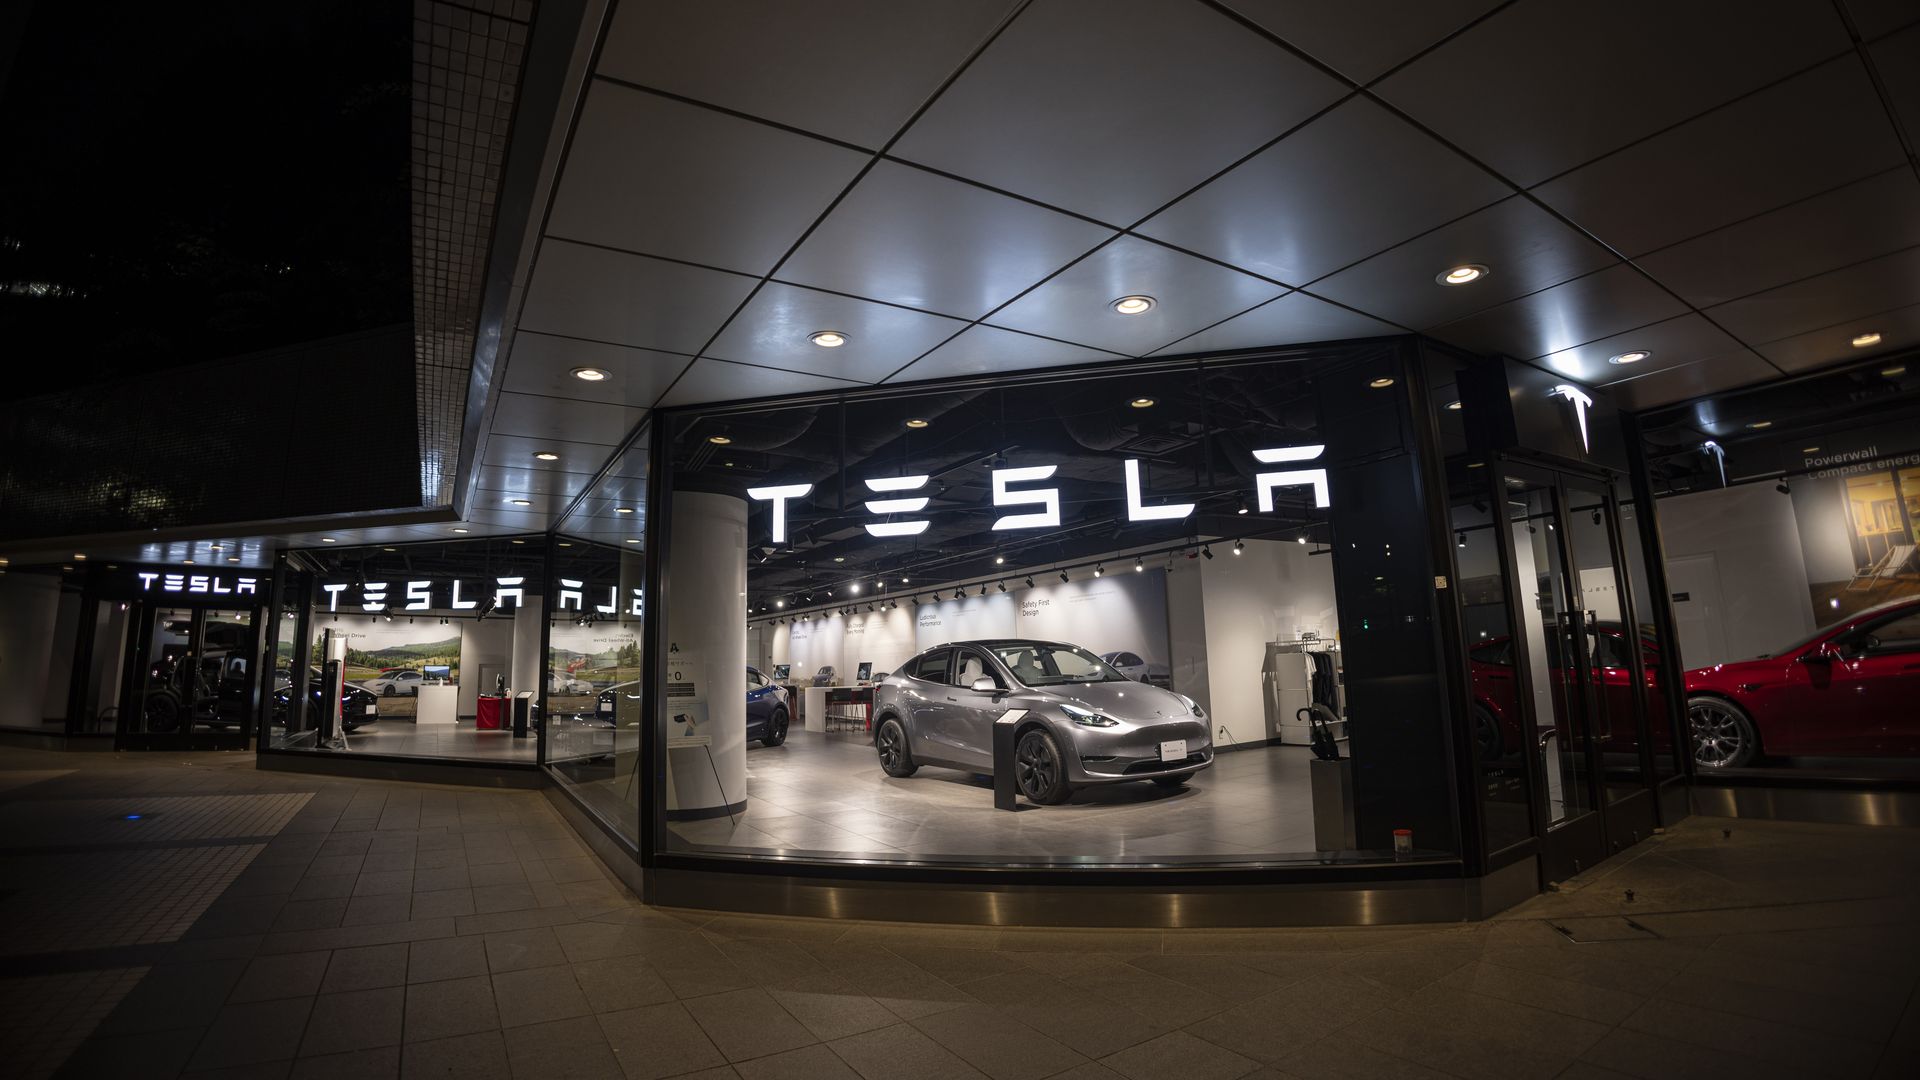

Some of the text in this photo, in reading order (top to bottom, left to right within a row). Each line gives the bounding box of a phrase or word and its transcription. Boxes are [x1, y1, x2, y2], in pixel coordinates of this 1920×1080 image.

[1804, 445, 1878, 468] Powerwall
[1808, 462, 1873, 480] Compact
[747, 444, 1330, 544] TESLA
[138, 572, 257, 594] TESLA
[323, 577, 525, 612] TESLA
[1022, 601, 1037, 609] Safety
[1022, 609, 1039, 617] Design
